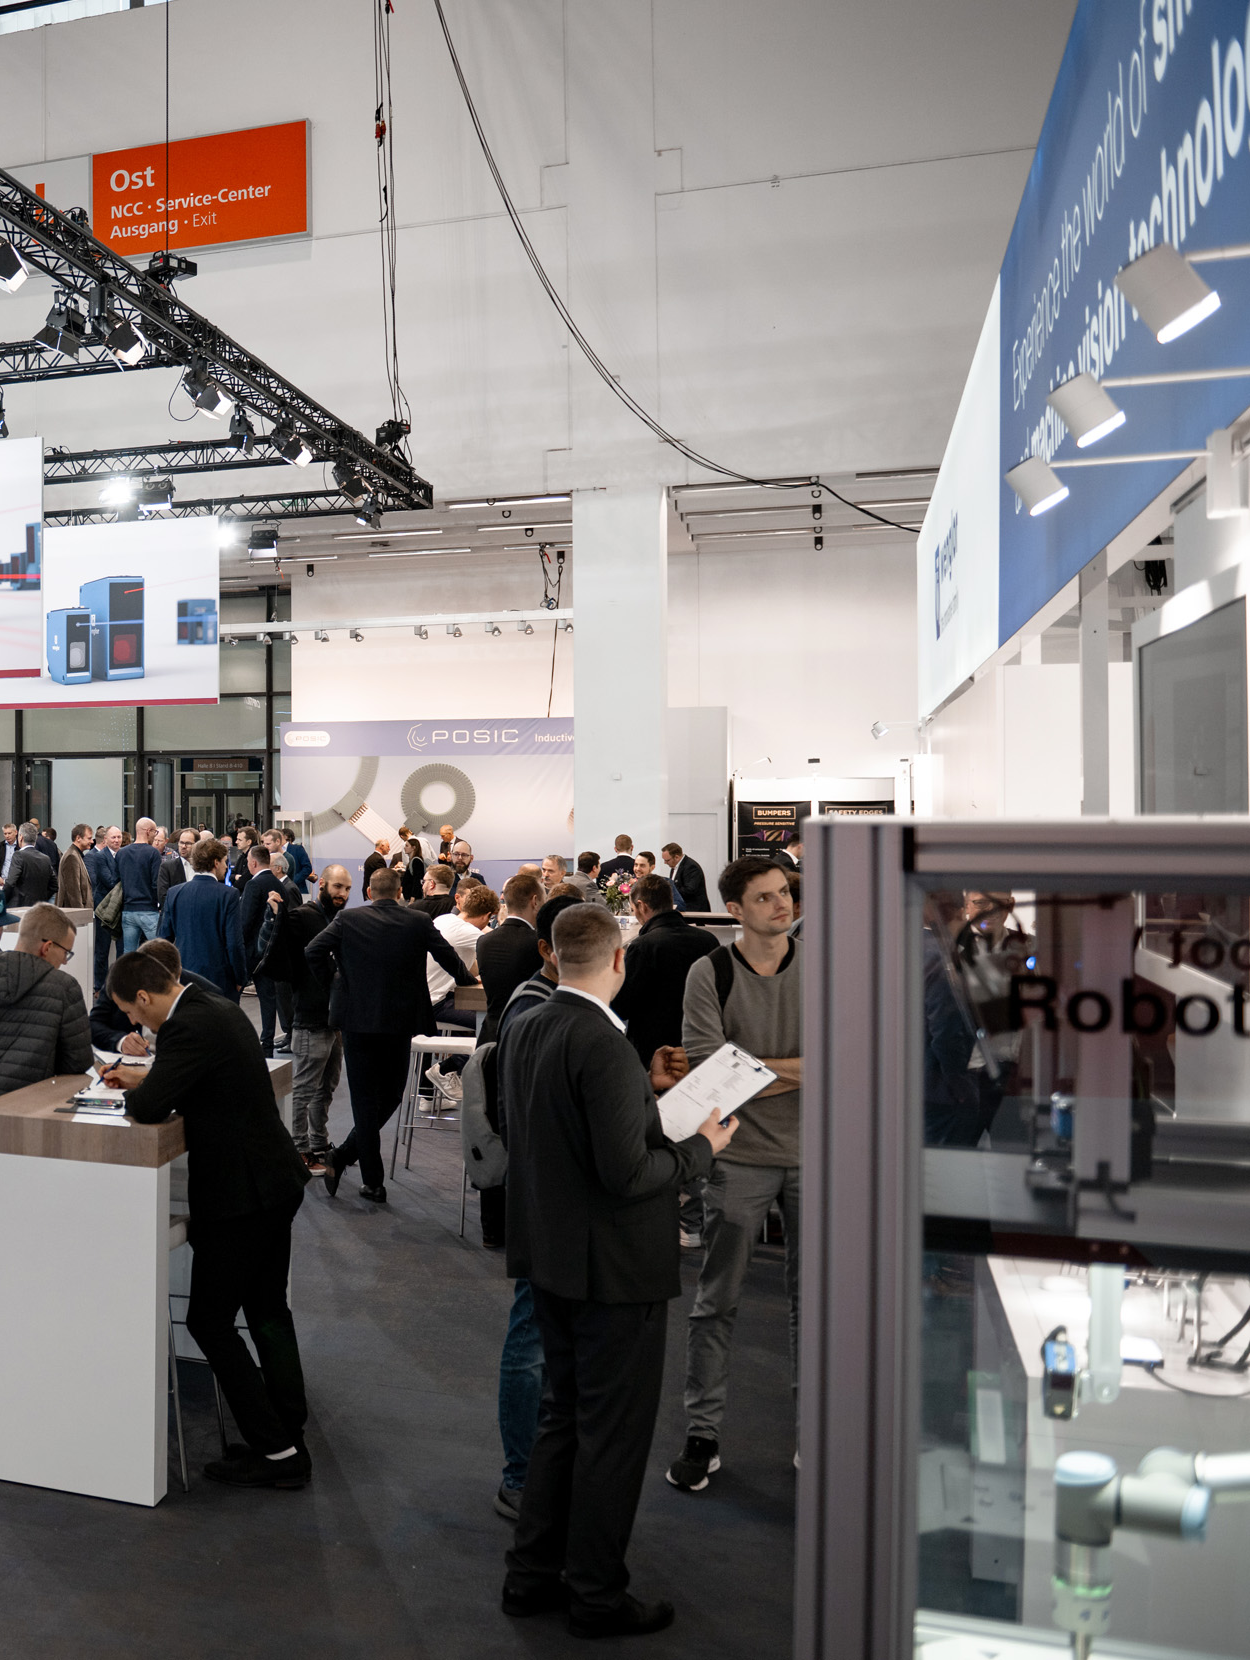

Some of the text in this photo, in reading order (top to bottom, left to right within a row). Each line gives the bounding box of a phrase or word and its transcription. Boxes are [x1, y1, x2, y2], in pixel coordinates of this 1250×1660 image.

[110, 166, 155, 192] Ost
[111, 185, 272, 219] NCC Service-Center
[1012, 257, 1061, 412] Experience
[1061, 204, 1082, 299] the
[1082, 61, 1125, 247] world
[1129, 0, 1148, 138] of
[110, 212, 217, 239] Ausgang Exit
[432, 729, 519, 743] POSIC
